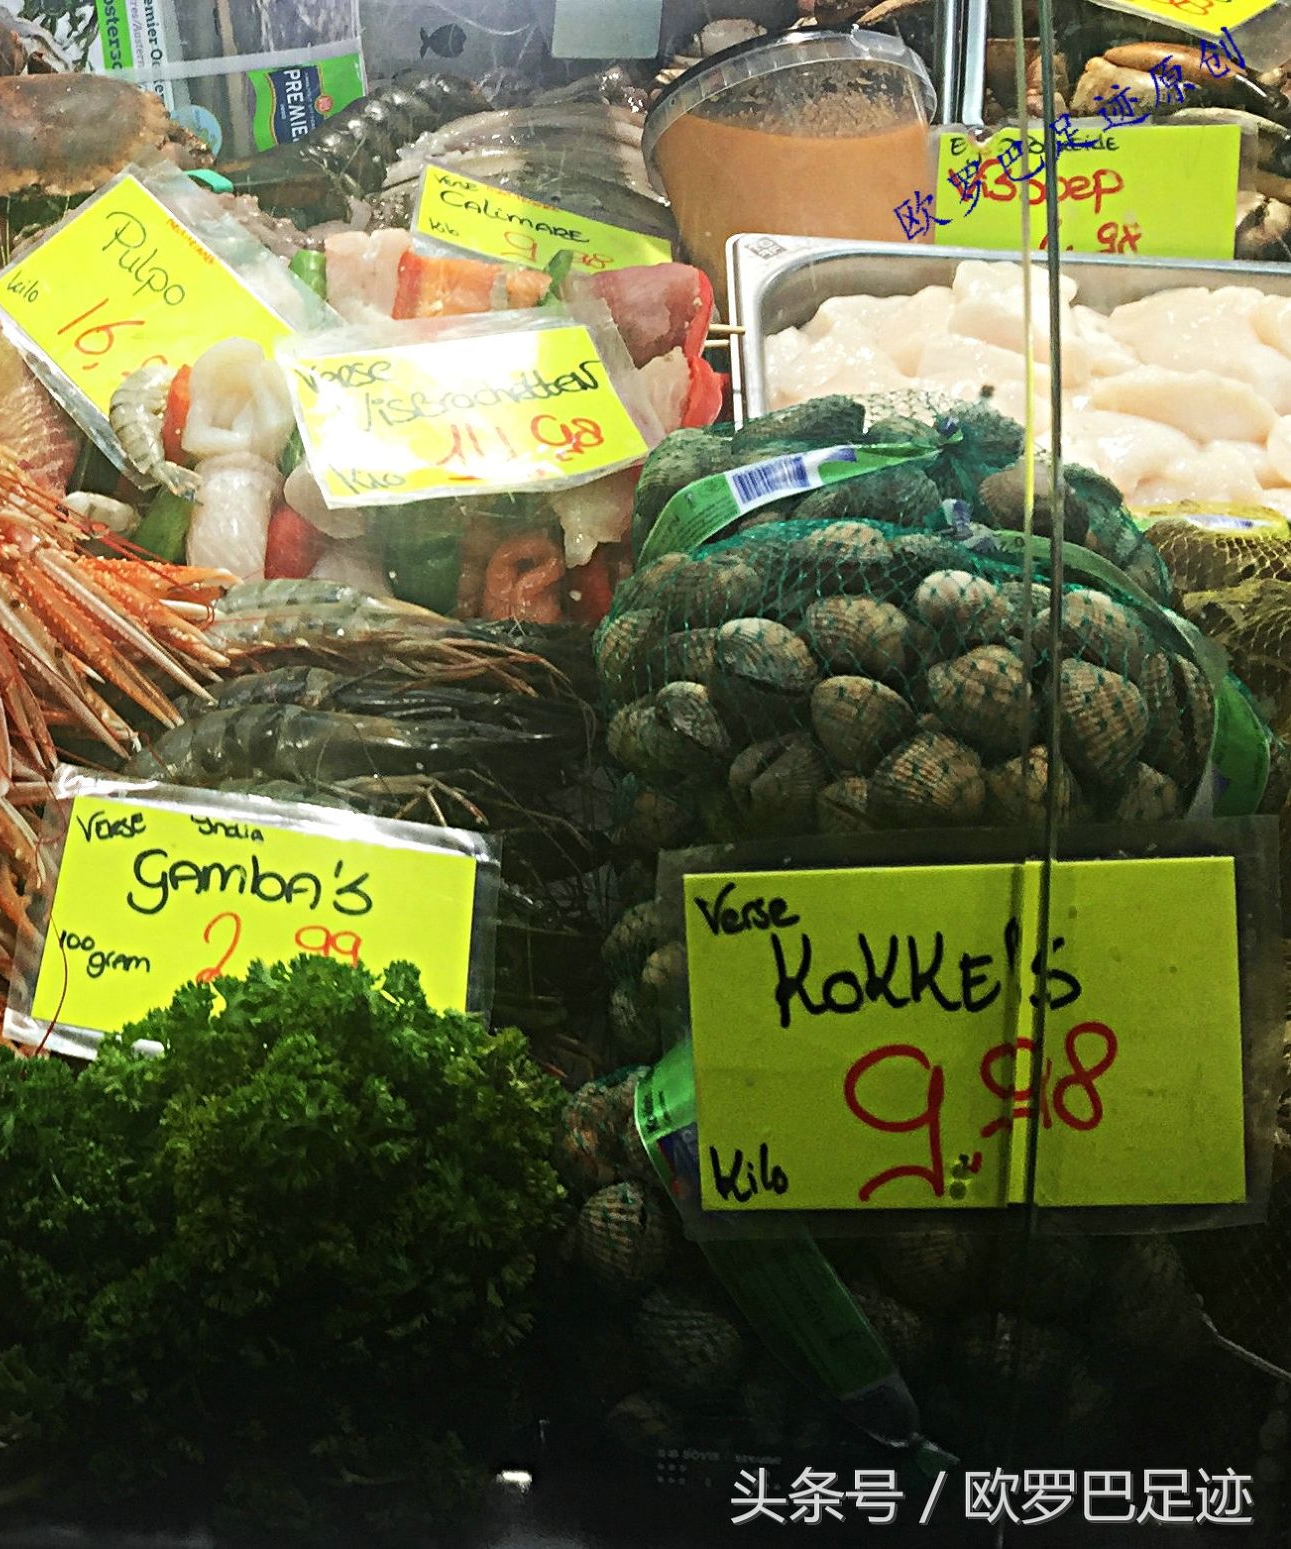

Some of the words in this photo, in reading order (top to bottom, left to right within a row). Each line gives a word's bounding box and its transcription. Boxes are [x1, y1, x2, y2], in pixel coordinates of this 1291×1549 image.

[284, 69, 309, 142] PREMIE
[102, 211, 186, 306] Pulpo
[694, 883, 800, 936] Verse
[709, 1142, 789, 1201] Kilo
